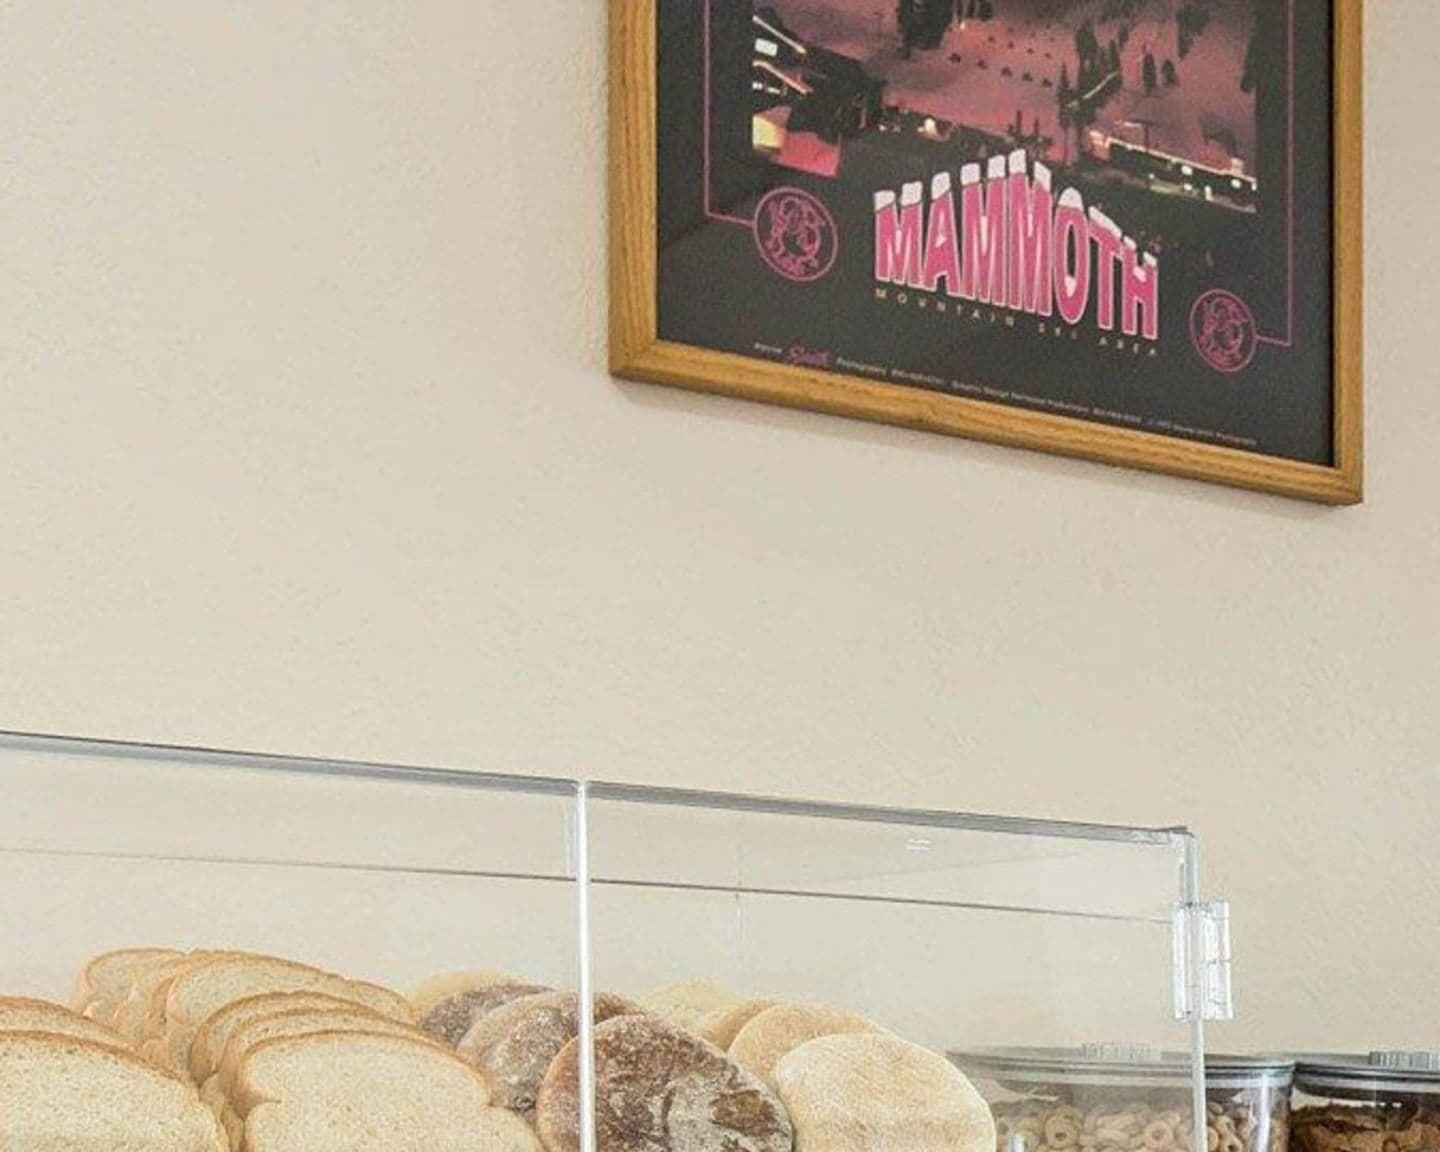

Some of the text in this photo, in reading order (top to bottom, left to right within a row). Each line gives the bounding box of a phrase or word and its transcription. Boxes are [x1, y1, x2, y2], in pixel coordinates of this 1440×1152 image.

[874, 149, 1158, 340] MAMMOTH
[875, 288, 1015, 327] MOUNTAIN
[1099, 336, 1157, 356] AREA
